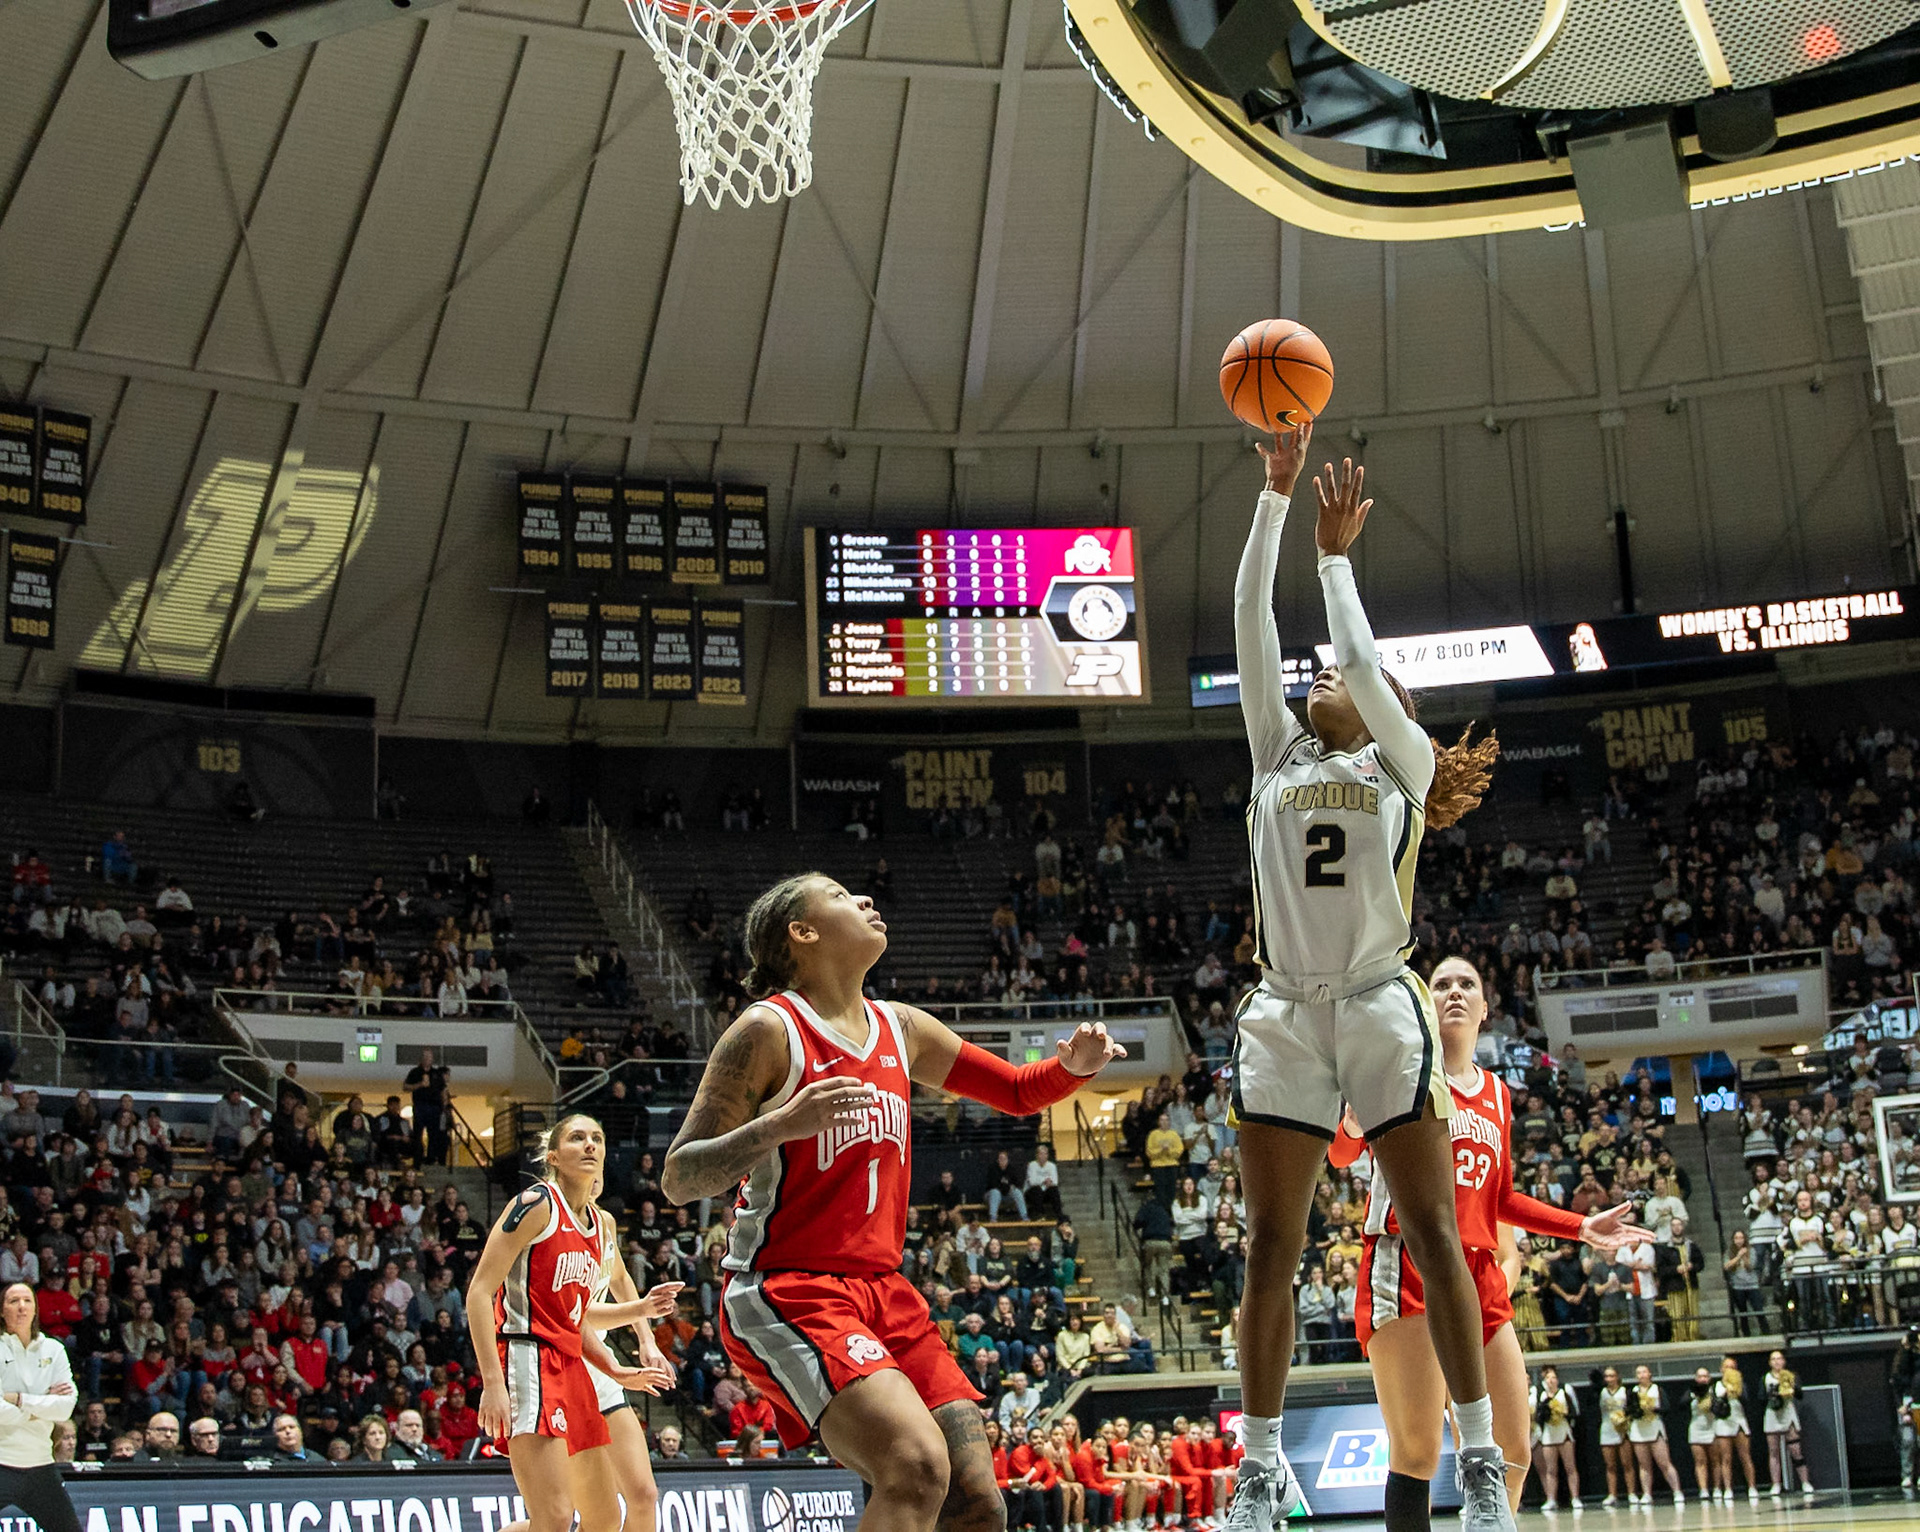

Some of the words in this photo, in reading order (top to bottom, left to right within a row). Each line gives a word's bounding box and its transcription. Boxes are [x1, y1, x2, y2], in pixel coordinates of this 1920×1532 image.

[830, 536, 837, 545] 0
[842, 535, 888, 545] Greene
[923, 535, 932, 546] 3
[947, 535, 955, 546] 1
[971, 535, 978, 546] 1
[992, 535, 1001, 546] 0
[1017, 535, 1024, 546] 1
[523, 549, 559, 566] 1994
[577, 553, 612, 569] 1995
[833, 550, 838, 559] 1
[843, 549, 882, 559] Harris
[947, 548, 955, 560] 2
[969, 548, 979, 560] 0
[994, 549, 1001, 560] 1
[1016, 549, 1024, 560] 2
[729, 560, 765, 575] 2010
[831, 564, 838, 573] 4
[924, 562, 933, 574] 0
[949, 562, 956, 574] 1
[970, 562, 979, 574] 2
[993, 562, 1002, 574] 0
[1016, 562, 1026, 574] 0
[826, 577, 839, 587] 23
[922, 576, 936, 588] 13
[947, 576, 957, 588] 0
[971, 576, 980, 588] 2
[994, 576, 1003, 588] 0
[1018, 576, 1026, 588] 2
[827, 592, 839, 601] 32
[844, 591, 904, 601] McMahon
[925, 590, 934, 602] 3
[949, 590, 957, 601] 7
[972, 590, 980, 601] 7
[995, 590, 1004, 602] 0
[1018, 590, 1027, 602] 2
[926, 608, 934, 616] P
[973, 608, 980, 616] A
[1020, 607, 1026, 616] F
[1658, 605, 1763, 639] WOMEN'S
[1766, 590, 1904, 627] BASKETBALL
[833, 624, 840, 634] 2
[845, 623, 883, 634] Jones
[926, 623, 937, 634] 11
[950, 623, 958, 634] 2
[973, 622, 982, 634] 2
[996, 622, 1006, 634] 0
[1022, 622, 1028, 633] 1
[1718, 629, 1757, 653] VS.
[1760, 618, 1849, 650] ILLINOIS
[829, 638, 841, 648] 10
[845, 637, 880, 650] Terry
[927, 637, 936, 648] 4
[951, 637, 959, 648] 7
[974, 636, 982, 648] 2
[997, 636, 1006, 648] 0
[1020, 636, 1030, 648] 0
[549, 649, 590, 661] CHAMPS
[832, 653, 842, 662] 11
[846, 652, 892, 665] Layden
[928, 651, 936, 663] 3
[951, 651, 960, 663] 0
[974, 651, 984, 663] 0
[998, 651, 1007, 662] 0
[1021, 651, 1030, 662] 0
[1396, 649, 1406, 664] 5
[1436, 643, 1474, 660] 8:00
[1480, 640, 1507, 655] PM
[551, 671, 588, 687] 2017
[602, 672, 640, 689] 2019
[830, 667, 842, 677] 15
[847, 666, 904, 679] Reynolds
[954, 666, 960, 677] 1
[975, 665, 984, 677] 0
[999, 665, 1007, 676] 2
[1024, 665, 1030, 676] 1
[652, 674, 692, 691] 2023
[702, 677, 741, 694] 2023
[829, 681, 842, 691] 33
[847, 680, 893, 693] Layden
[929, 680, 937, 691] 2
[953, 680, 961, 691] 3
[978, 679, 985, 691] 1
[999, 679, 1008, 691] 0
[1024, 679, 1031, 691] 1
[1602, 702, 1691, 739] PAINT
[1723, 715, 1767, 744] 105
[198, 744, 241, 773] 103
[1503, 744, 1581, 762] WABASH
[1605, 731, 1695, 769] CREW
[904, 750, 993, 778] PAINT
[803, 778, 881, 792] WABASH
[1023, 769, 1066, 796] 104
[906, 779, 994, 809] CREW
[1277, 781, 1379, 816] PURDUE
[1305, 824, 1346, 887] 2
[1447, 1109, 1472, 1138] HIO
[1455, 1148, 1491, 1190] 23
[865, 1157, 881, 1215] 1
[568, 1293, 582, 1327] 4
[645, 1490, 745, 1532] OVEN
[791, 1490, 856, 1518] PURDUE
